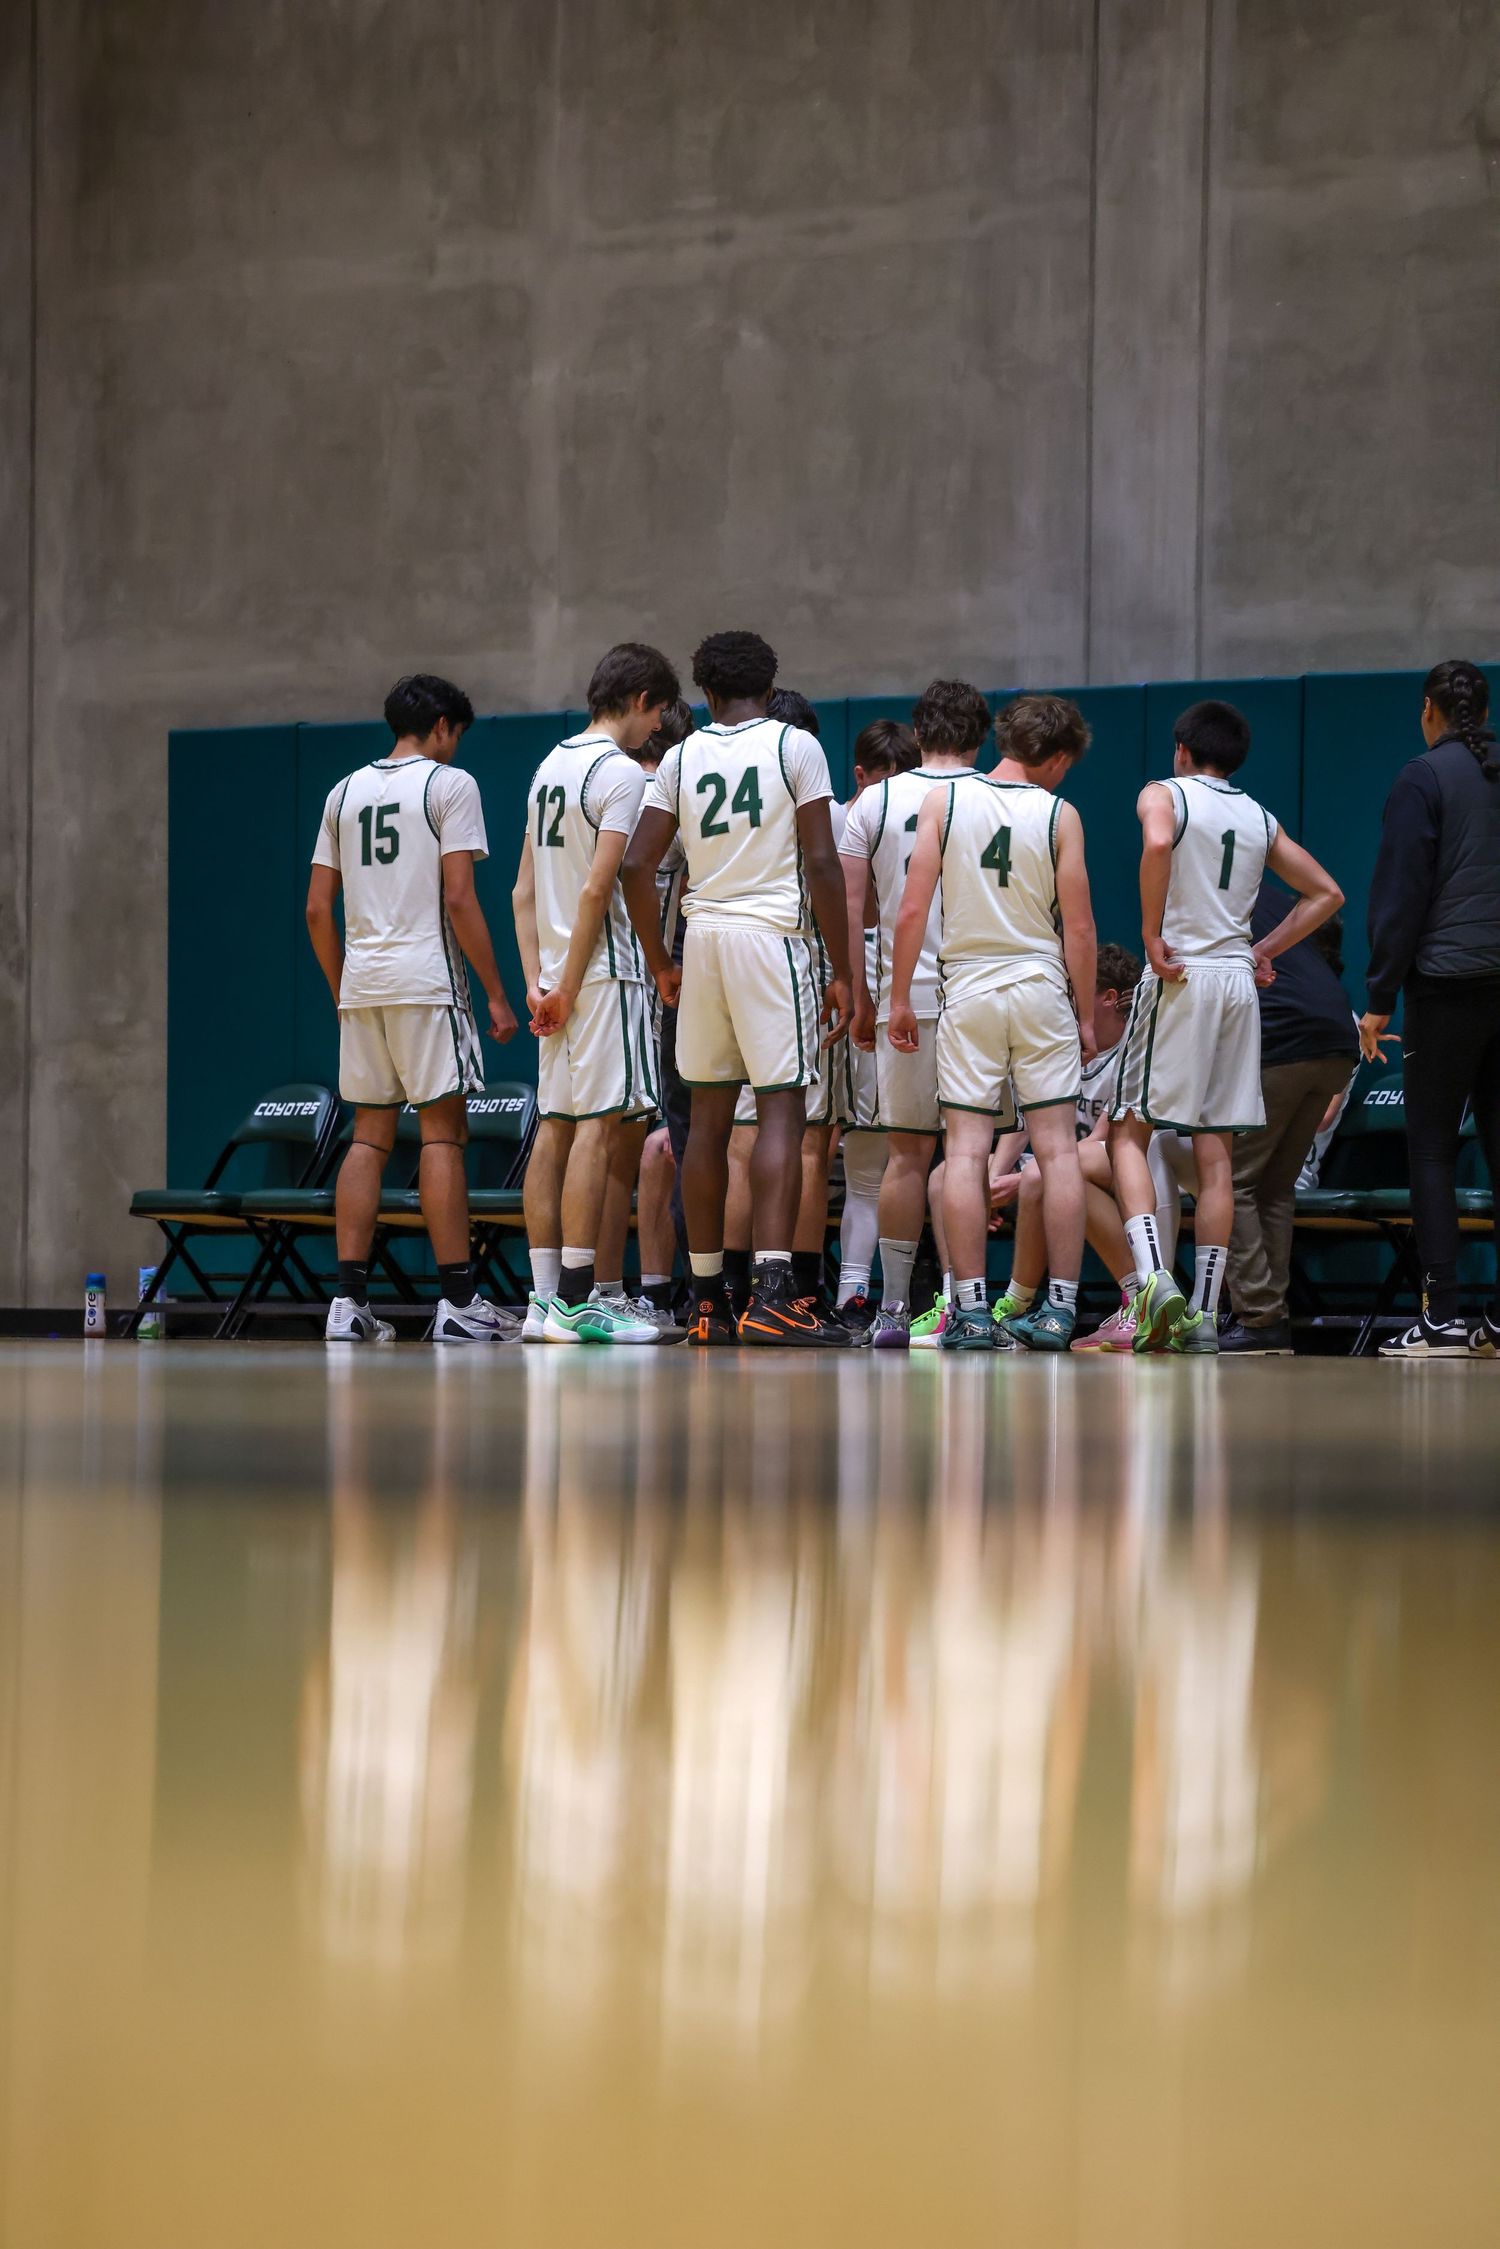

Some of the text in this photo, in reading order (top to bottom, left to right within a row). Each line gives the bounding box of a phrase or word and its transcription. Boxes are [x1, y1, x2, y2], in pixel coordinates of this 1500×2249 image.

[358, 802, 400, 866] 15
[537, 784, 566, 848] 12
[696, 766, 763, 839] 24
[980, 825, 1012, 888] 4
[1218, 829, 1235, 890] 1
[254, 1101, 321, 1116] COYOTES
[87, 1292, 97, 1327] core
